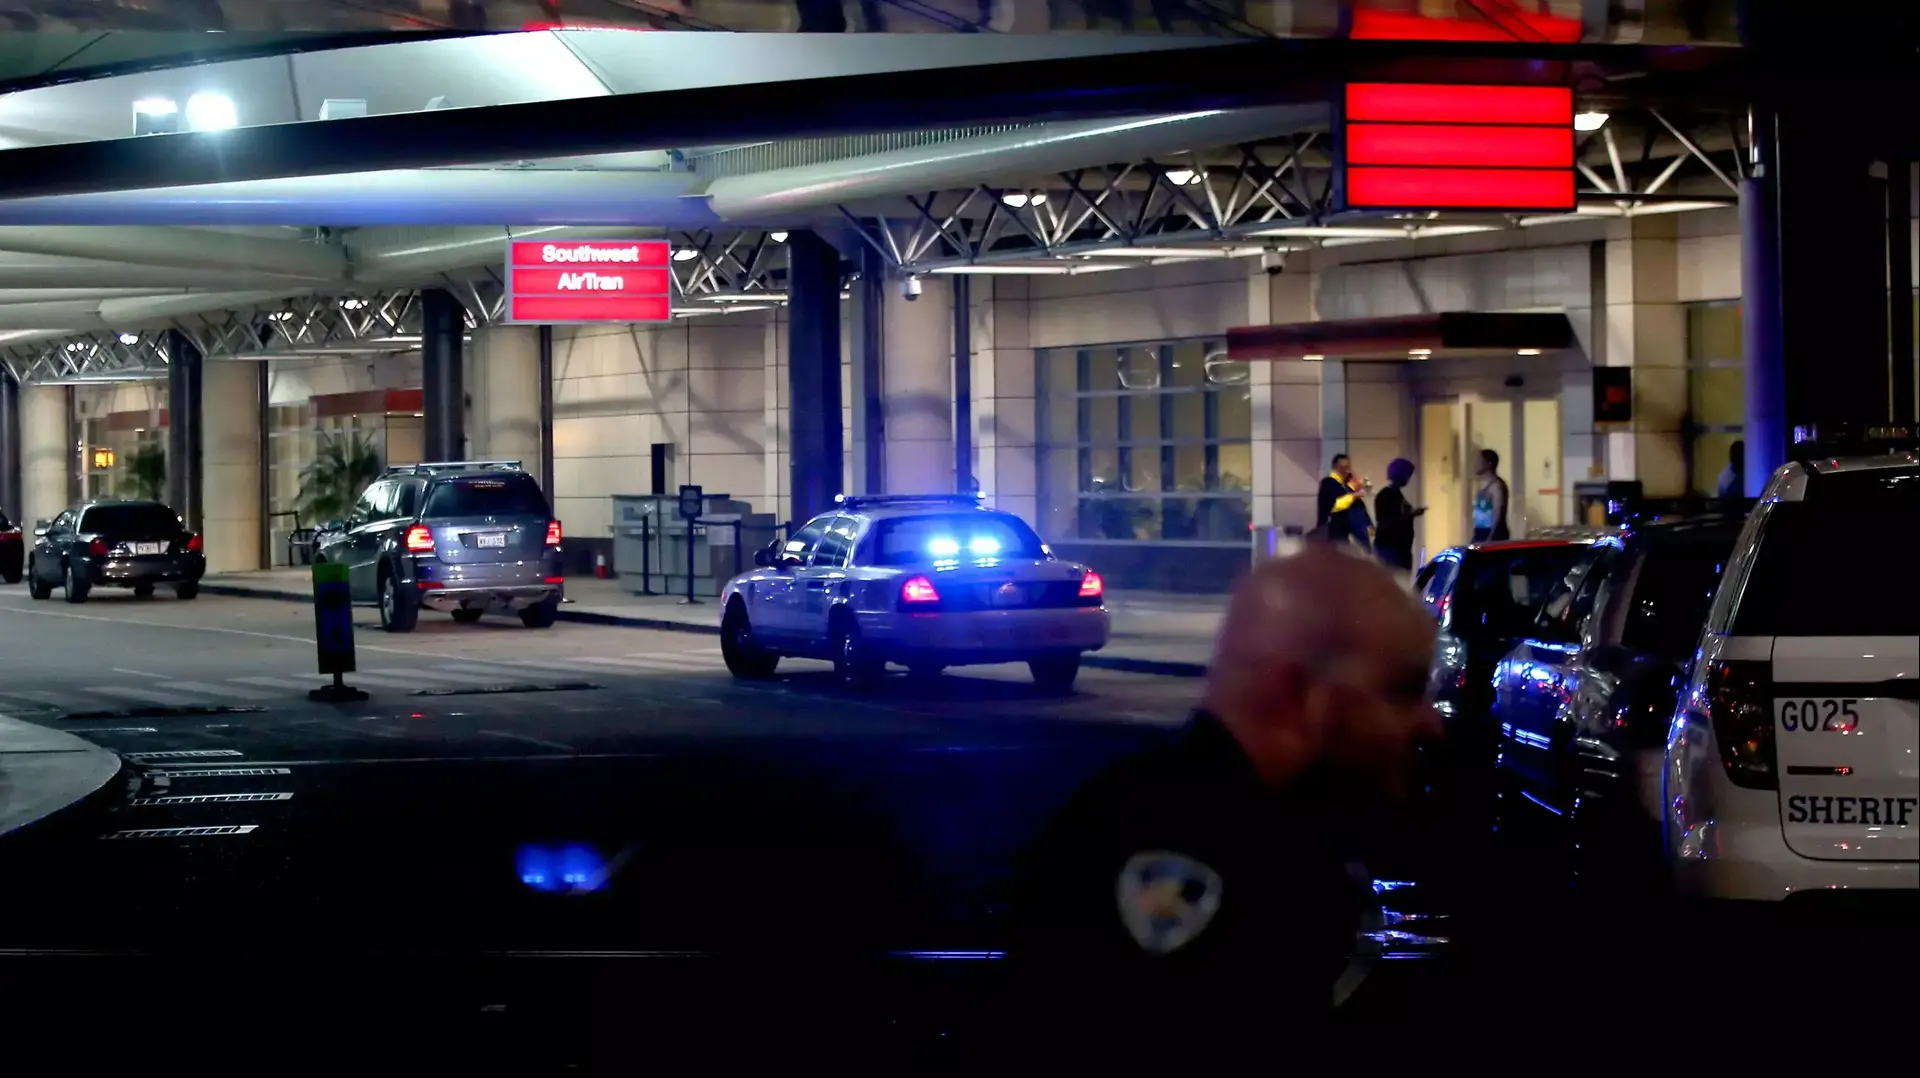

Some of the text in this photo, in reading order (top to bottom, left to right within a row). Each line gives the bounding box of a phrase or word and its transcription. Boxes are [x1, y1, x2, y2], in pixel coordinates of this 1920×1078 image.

[542, 244, 639, 263] Southwest
[557, 272, 624, 290] AirTran
[1782, 700, 1858, 732] G025
[1788, 796, 1917, 825] SHERIF
